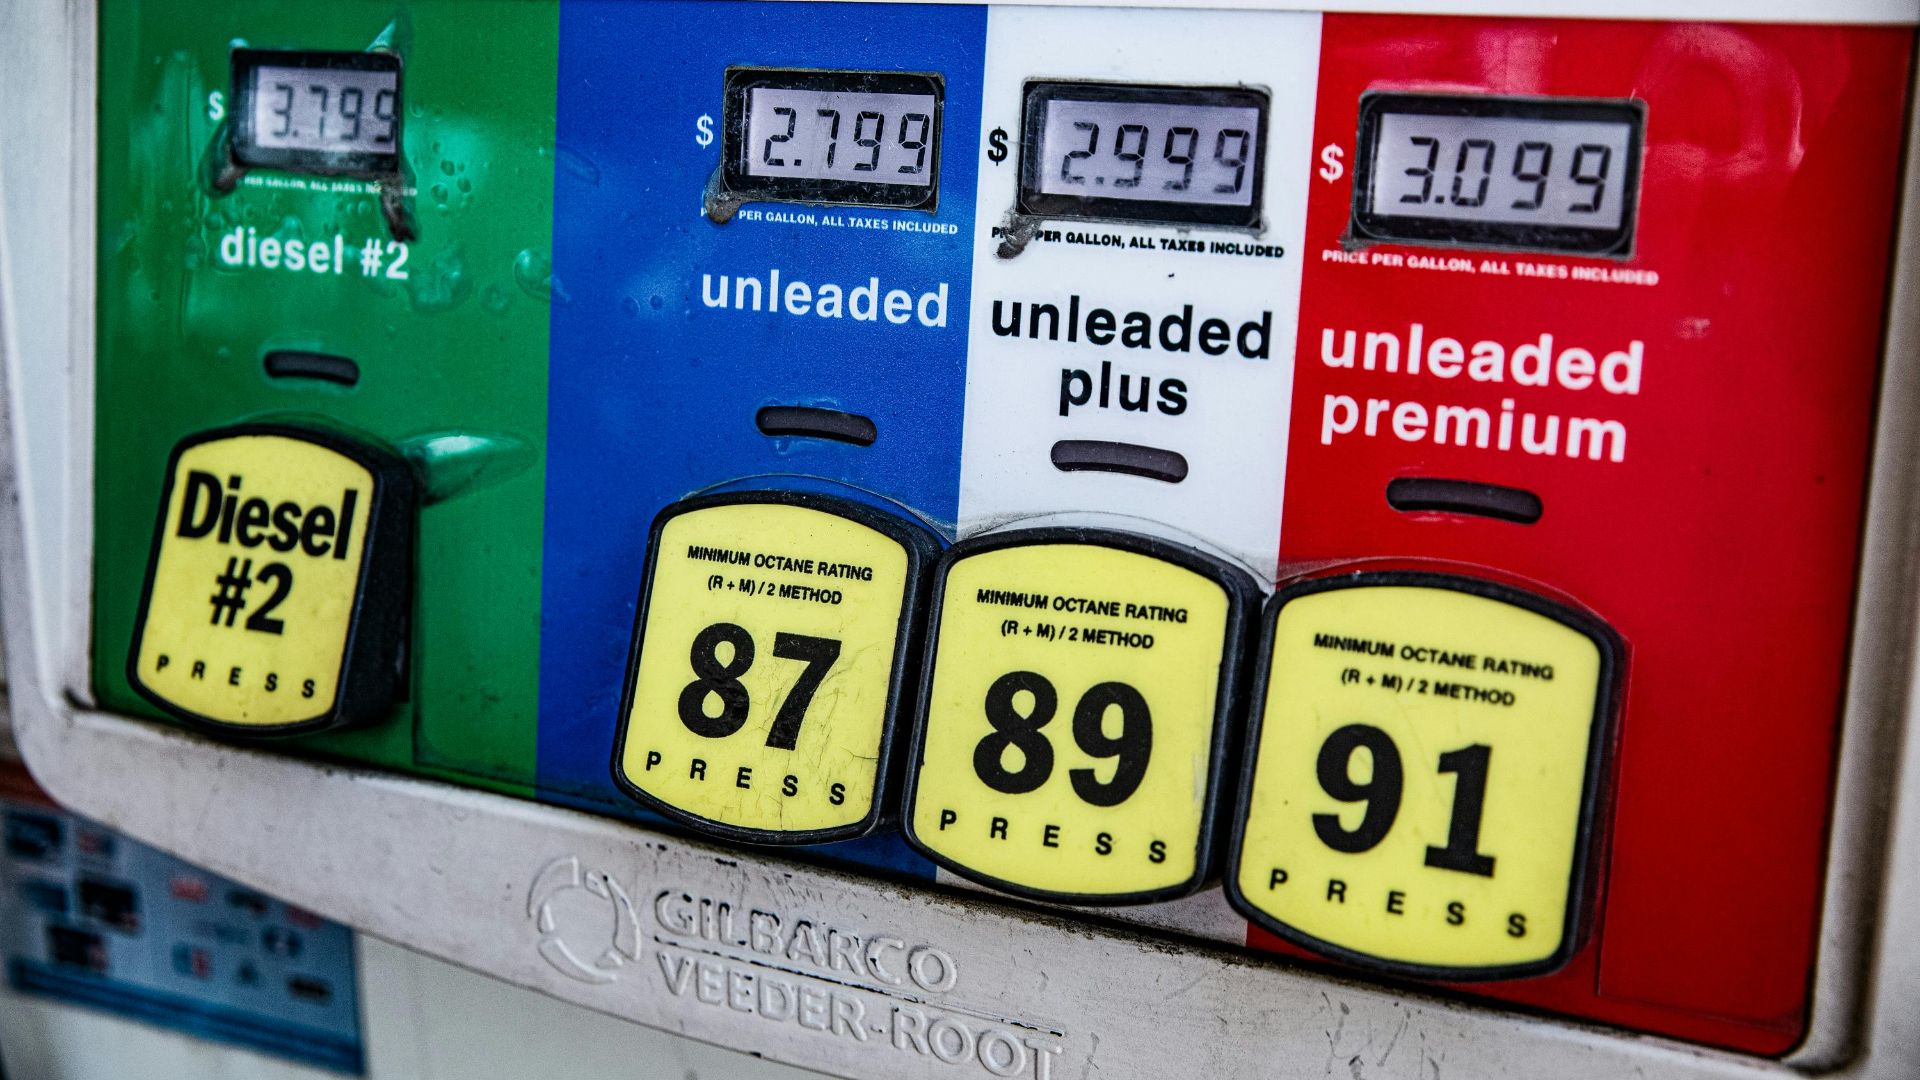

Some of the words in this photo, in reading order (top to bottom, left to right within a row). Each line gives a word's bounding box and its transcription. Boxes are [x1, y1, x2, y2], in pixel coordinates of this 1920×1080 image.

[695, 113, 715, 149] $
[763, 106, 931, 175] 2.799
[987, 127, 1009, 166] $
[1060, 121, 1250, 194] 2.999
[1318, 143, 1344, 184] $
[1400, 136, 1612, 213] 3.099
[738, 209, 763, 221] PER
[765, 211, 818, 227] GALLON,
[821, 216, 845, 228] ALL
[849, 217, 889, 230] TAXES
[892, 220, 958, 235] INCLUDED
[1034, 229, 1062, 242] PER
[1065, 232, 1125, 249] GALLON,
[1129, 236, 1156, 250] ALL
[1160, 238, 1206, 252] TAXES
[1210, 240, 1285, 258] INCLUDED
[220, 226, 344, 275] diesel
[360, 238, 410, 280] #2
[1322, 249, 1369, 265] PRICE
[1371, 252, 1404, 268] PER
[1406, 255, 1476, 274] GALLON,
[1479, 259, 1511, 275] ALL
[1514, 261, 1569, 280] TAXES
[1571, 265, 1659, 287] INCLUDED
[701, 269, 949, 328] unleaded
[991, 295, 1273, 360] unleaded
[1320, 323, 1645, 395] unleaded
[1059, 361, 1189, 417] plus
[1320, 394, 1628, 463] premium
[176, 469, 358, 561] Diesel
[687, 545, 751, 566] MINIMUM
[754, 554, 814, 574] OCTANE
[817, 561, 873, 581] RATING
[210, 556, 294, 636] #2
[779, 584, 842, 605] METHOD
[976, 589, 1049, 609] MINIMUM
[1052, 596, 1120, 617] OCTANE
[1125, 603, 1188, 623] RATING
[1082, 628, 1155, 649] METHOD
[1313, 633, 1395, 658] MINIMUM
[1400, 645, 1477, 670] OCTANE
[1482, 656, 1555, 681] RATING
[155, 654, 316, 699] PRESS
[677, 622, 843, 751] 87
[1434, 680, 1516, 707] METHOD
[973, 670, 1154, 808] 89
[645, 751, 846, 806] PRESS
[1311, 723, 1497, 879] 91
[939, 809, 1167, 864] PRESS
[1268, 868, 1528, 939] PRESS
[653, 888, 959, 994] GILBARCO
[655, 950, 1063, 1080] VEEDER-ROOT
